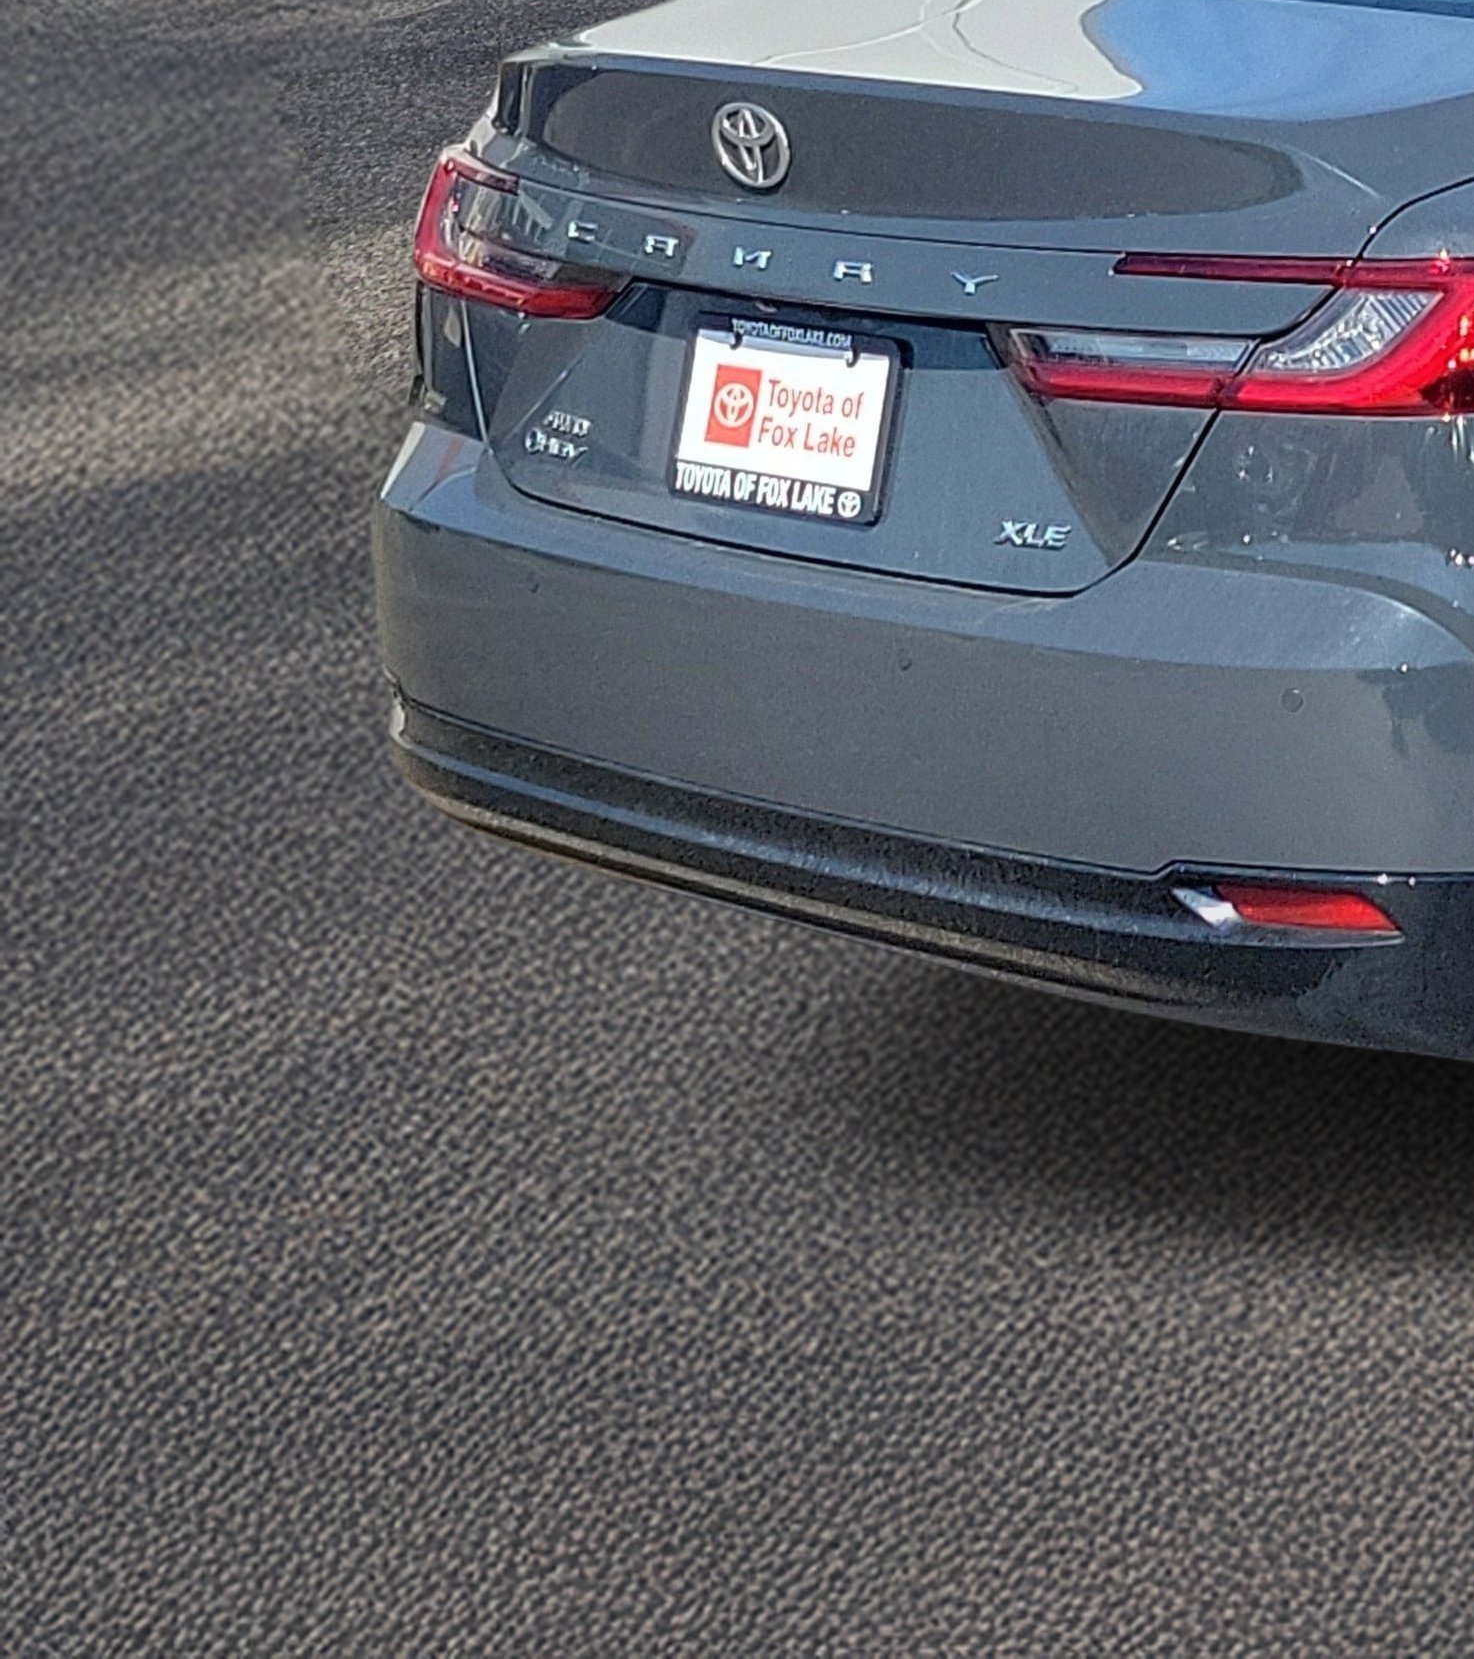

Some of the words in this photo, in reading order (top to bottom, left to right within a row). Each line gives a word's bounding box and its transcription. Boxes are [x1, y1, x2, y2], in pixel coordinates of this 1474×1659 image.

[567, 220, 999, 296] CAMRY
[768, 378, 834, 418] Toyota
[841, 391, 865, 419] of
[757, 416, 799, 449] Fox
[803, 422, 856, 458] Lake
[675, 461, 732, 499] TOYOTA
[733, 471, 758, 503] OF
[756, 475, 792, 509] FOX
[790, 482, 837, 515] LAKE
[993, 521, 1072, 548] XLE
